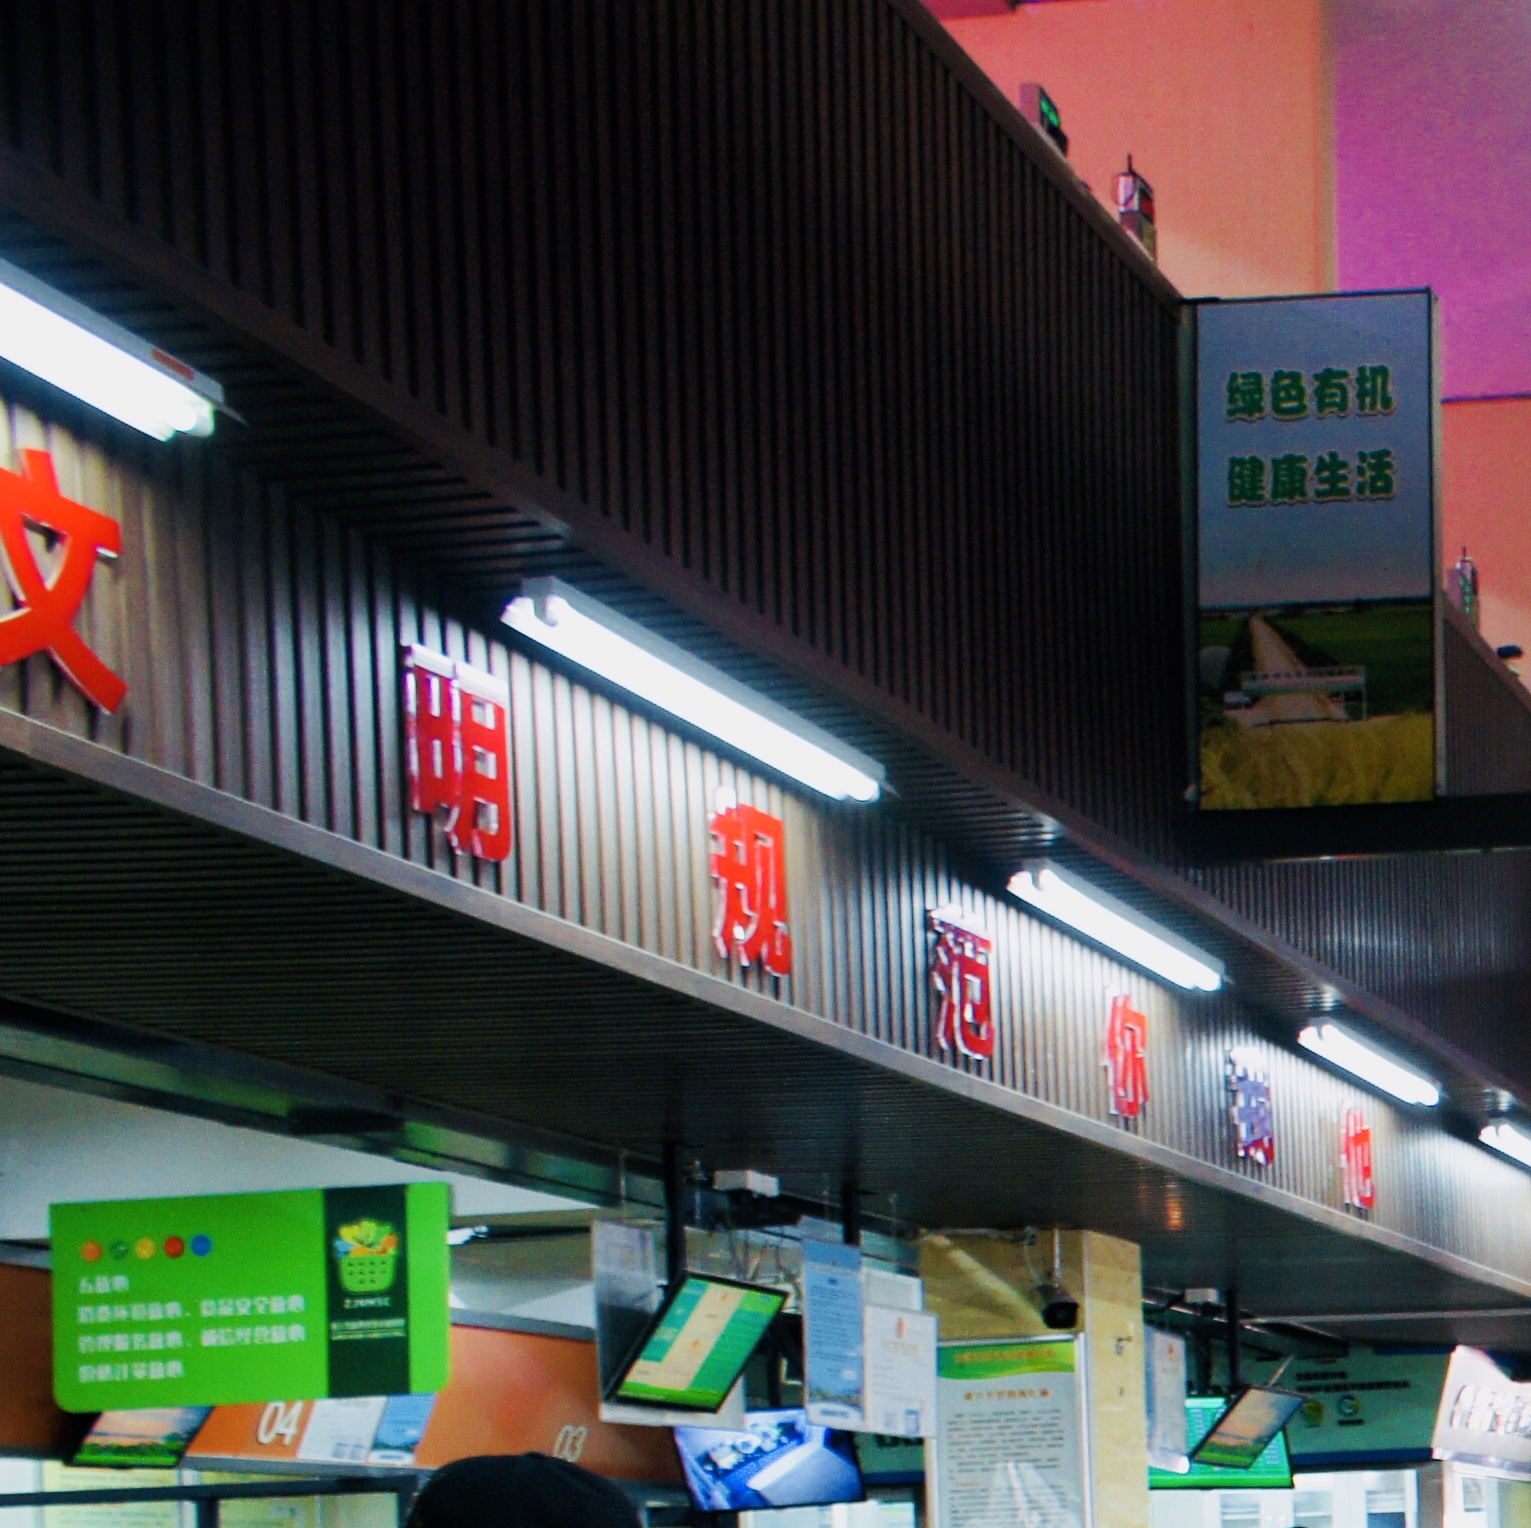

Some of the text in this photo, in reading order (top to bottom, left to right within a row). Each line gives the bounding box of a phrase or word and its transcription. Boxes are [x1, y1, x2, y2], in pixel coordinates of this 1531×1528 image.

[1226, 364, 1396, 423] 绿色有机
[1227, 448, 1396, 507] 健康生活
[257, 1400, 302, 1446] 04
